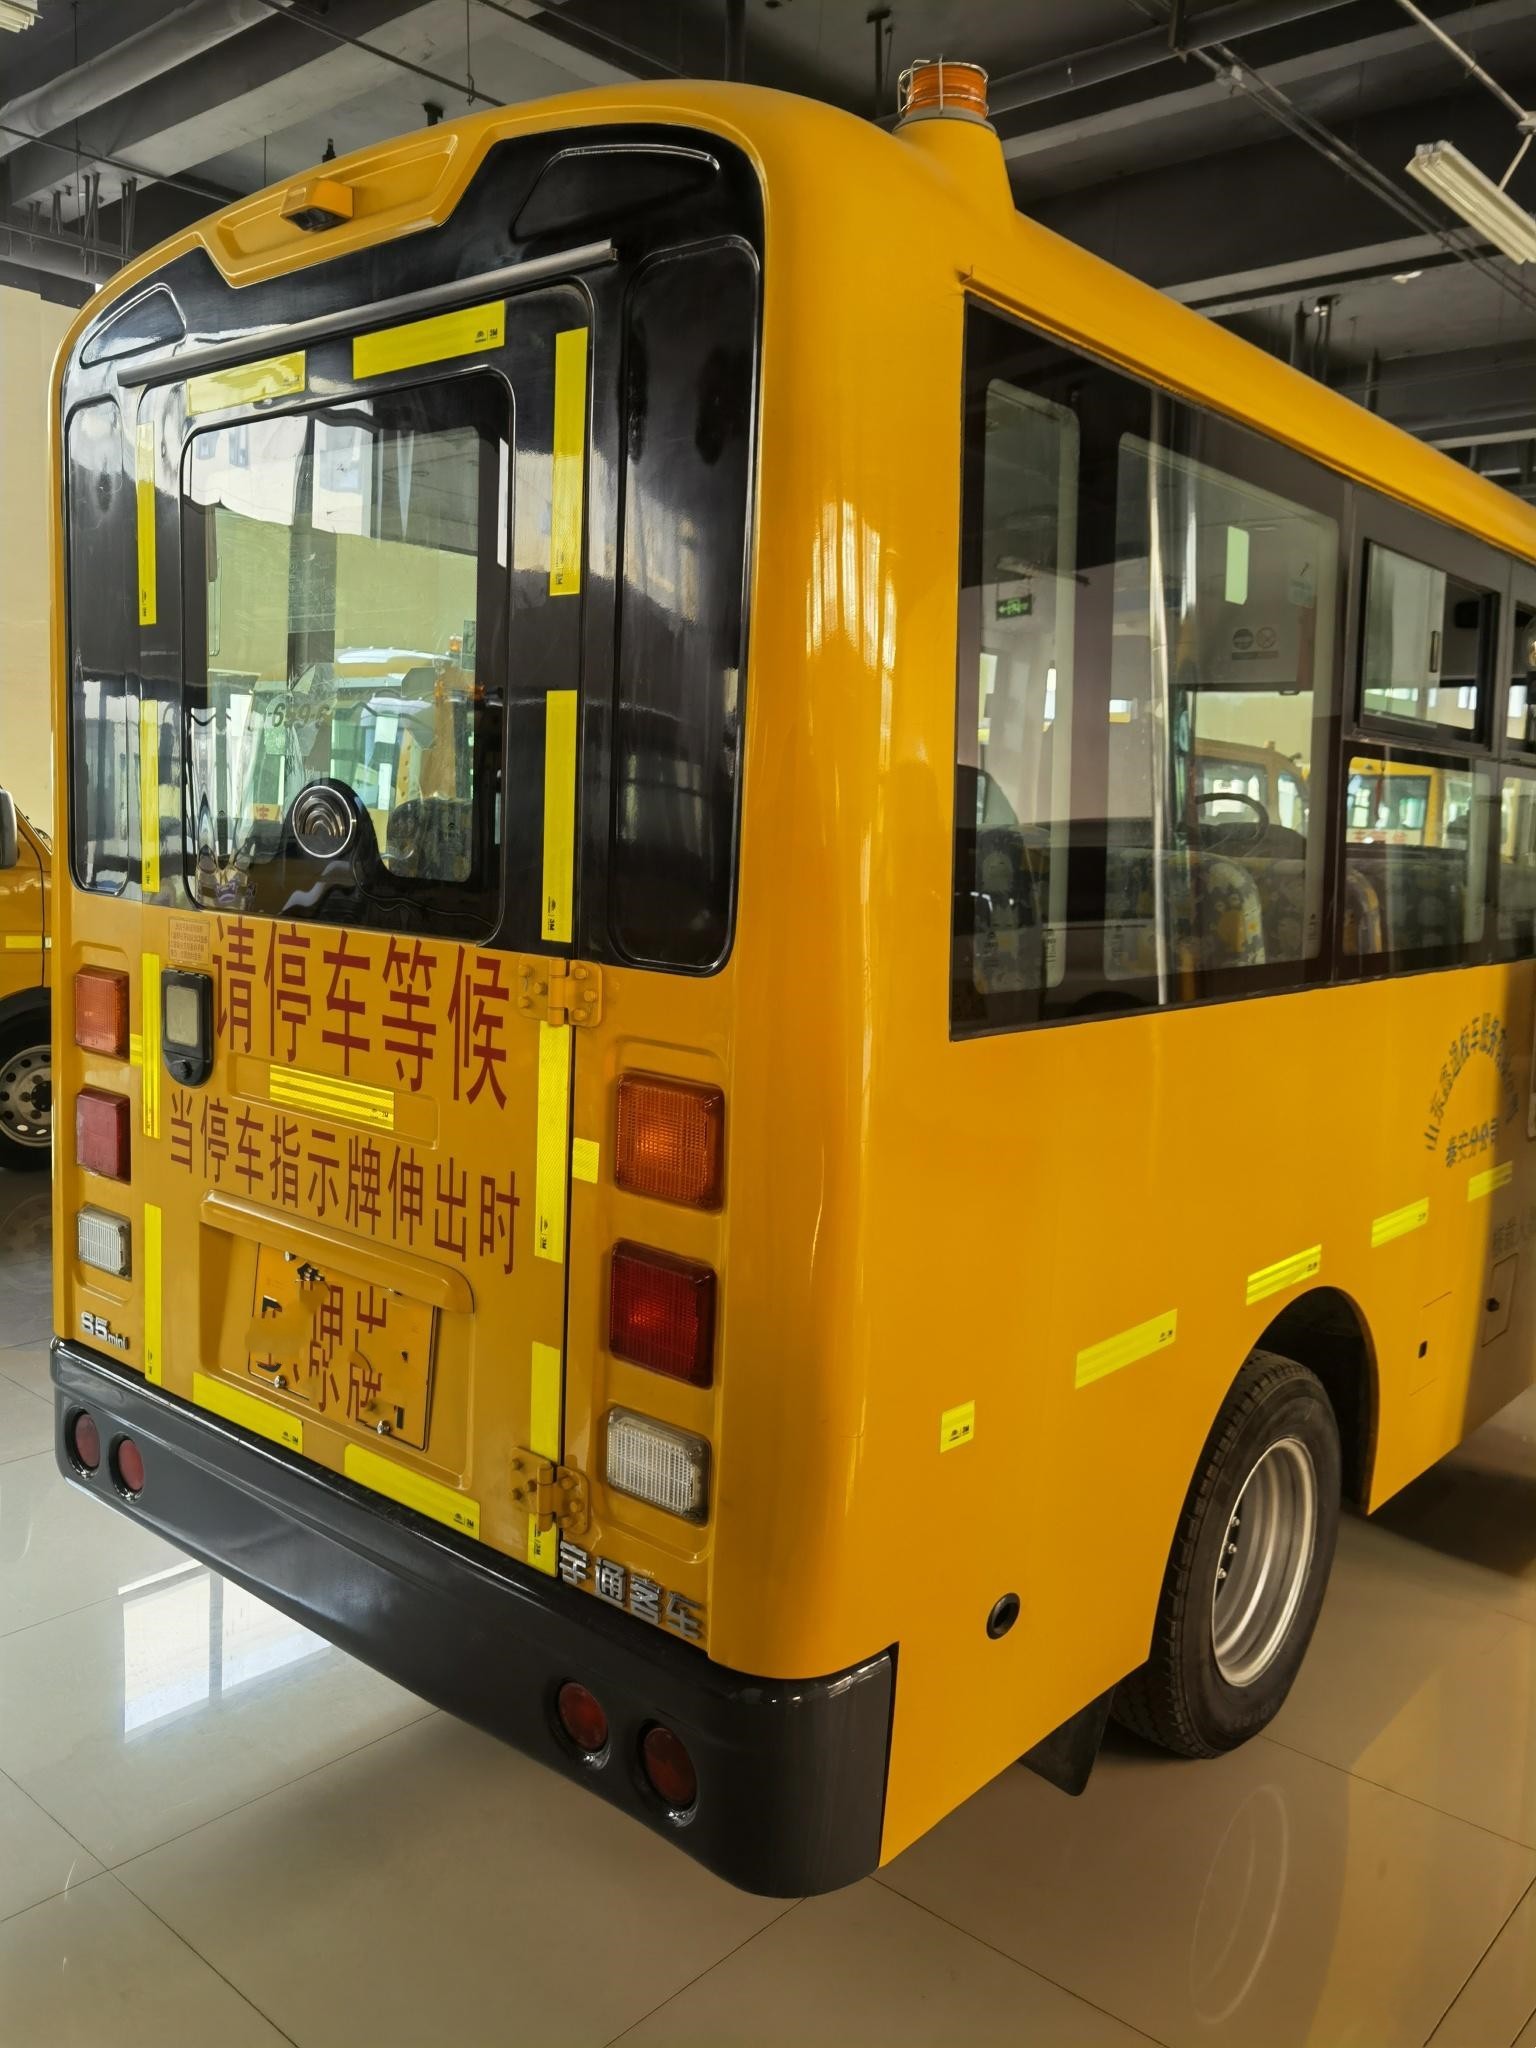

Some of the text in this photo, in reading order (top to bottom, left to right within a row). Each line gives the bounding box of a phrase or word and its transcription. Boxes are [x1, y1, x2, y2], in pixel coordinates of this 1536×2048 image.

[213, 915, 509, 1110] 请停车等候
[170, 1090, 520, 1275] 当停车指示牌伸出时
[559, 1539, 701, 1640] 宇通客车
